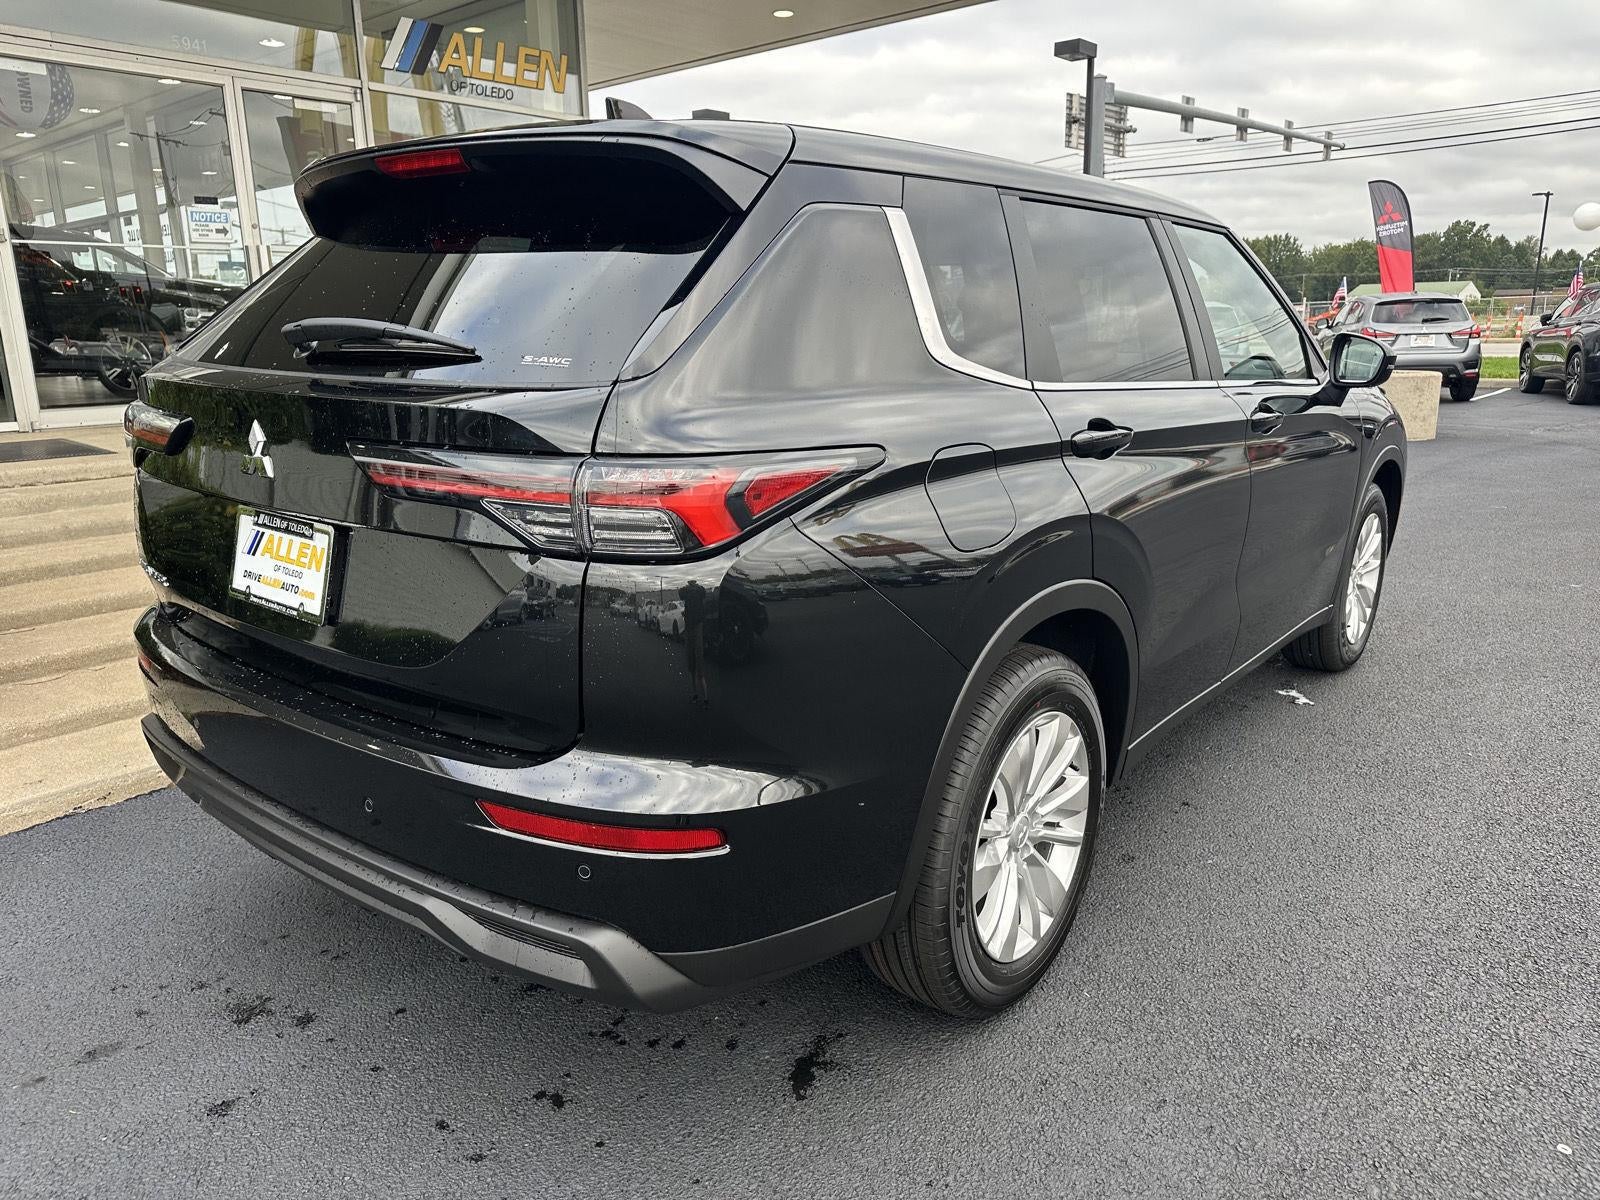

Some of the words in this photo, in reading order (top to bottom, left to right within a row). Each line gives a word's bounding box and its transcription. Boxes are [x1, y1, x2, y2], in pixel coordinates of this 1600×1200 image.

[171, 35, 207, 51] 5941
[438, 32, 568, 94] ALLEN
[450, 80, 467, 92] OF
[468, 83, 514, 100] TOLEDO
[192, 212, 227, 223] NOTICE
[522, 355, 572, 364] S-AWC
[264, 515, 280, 527] ALLEN
[261, 533, 325, 573] ALLEN
[273, 564, 282, 572] OF
[282, 565, 304, 579] TOLEDO
[955, 840, 968, 928] TOYO
